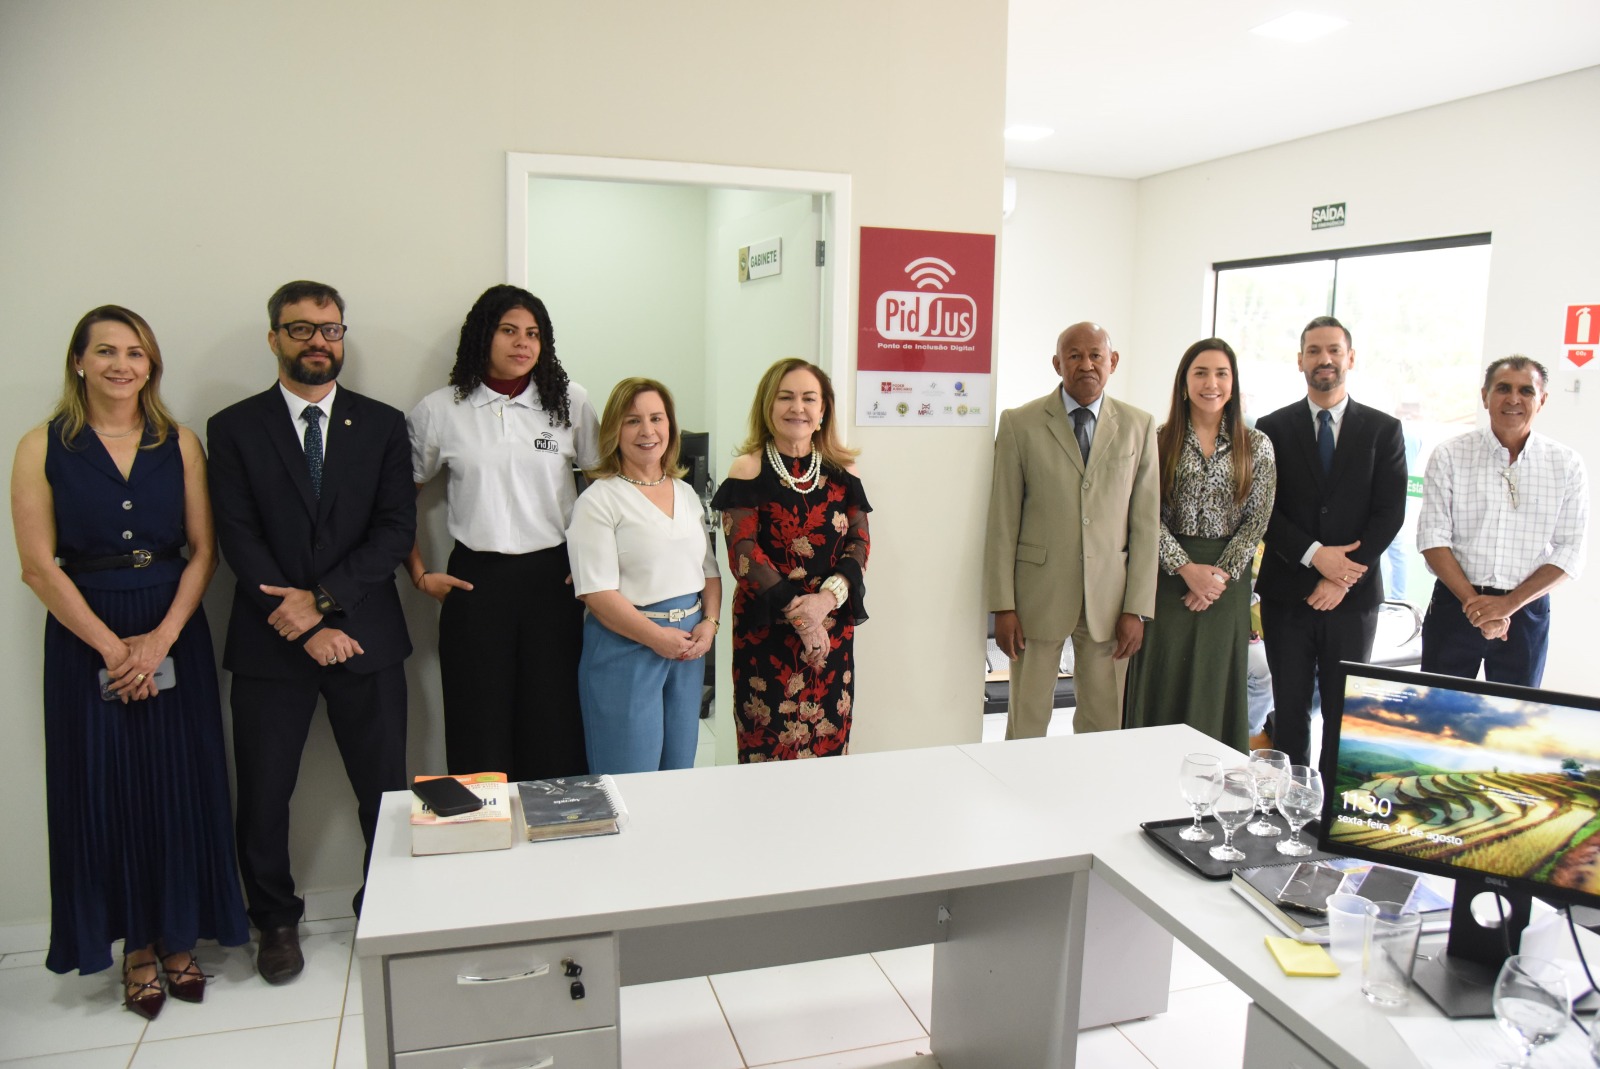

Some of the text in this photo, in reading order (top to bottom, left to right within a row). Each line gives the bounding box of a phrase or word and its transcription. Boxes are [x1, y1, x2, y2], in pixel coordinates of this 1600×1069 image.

[1312, 204, 1345, 223] SAÍDA
[751, 249, 777, 268] GABINETE
[877, 342, 901, 350] Ponto
[915, 343, 949, 351] Inclusão
[950, 344, 975, 352] Digital
[1340, 790, 1392, 817] 11:30
[1337, 814, 1463, 846] sexta-feira, 30 de agosto
